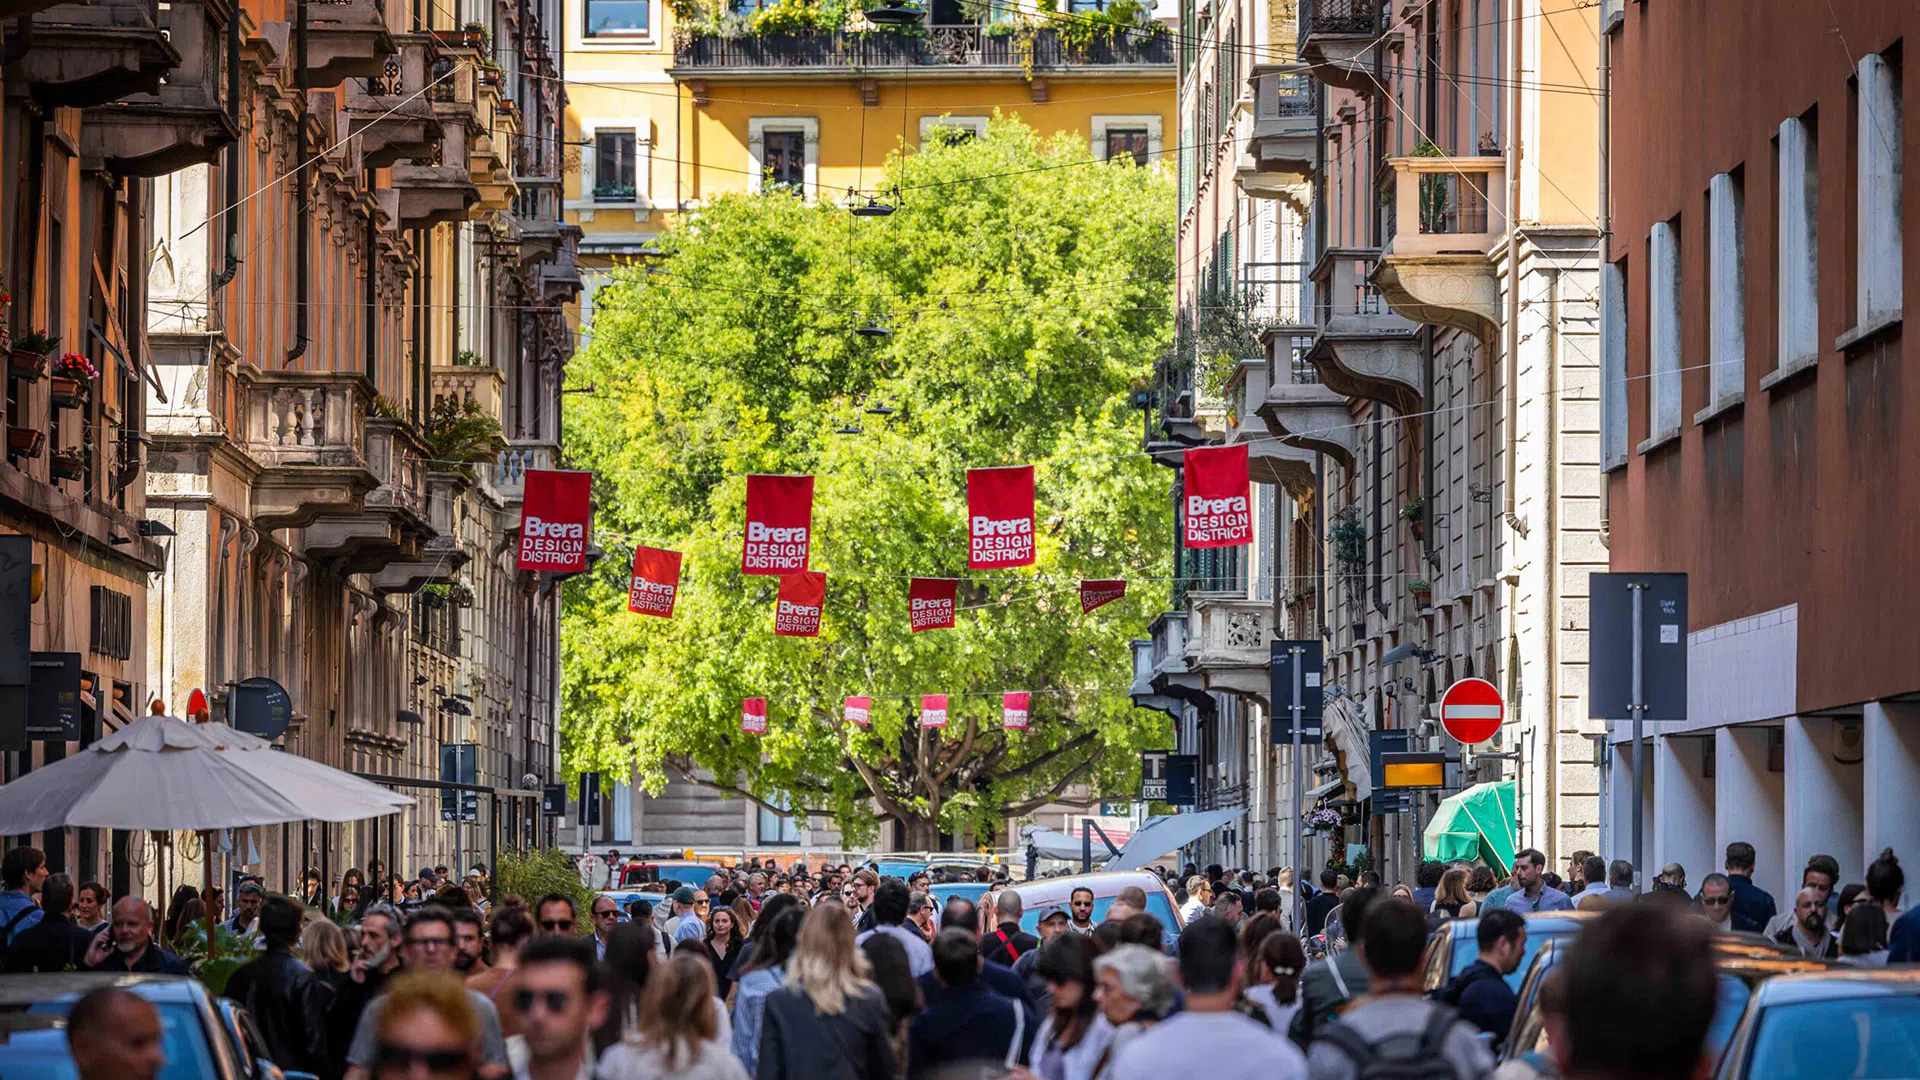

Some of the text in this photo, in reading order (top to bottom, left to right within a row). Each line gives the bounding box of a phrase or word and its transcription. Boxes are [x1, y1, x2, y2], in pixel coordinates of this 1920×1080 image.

[1188, 495, 1247, 515] Brera
[524, 516, 584, 539] Brera
[972, 516, 1031, 536] Brera
[1188, 512, 1248, 529] DESIGN
[748, 521, 807, 543] Brera
[1188, 525, 1248, 542] DISTRICT
[522, 538, 584, 552] DESIGN
[972, 533, 1032, 550] DESIGN
[521, 550, 582, 565] DISTRICT
[746, 543, 807, 557] DESIGN
[972, 546, 1032, 562] DISTRICT
[745, 556, 806, 569] DISTRICT
[633, 576, 675, 596] Brera
[631, 590, 673, 605] DESIGN
[911, 598, 952, 610] Brera
[630, 598, 671, 613] DISTRICT
[779, 600, 820, 616] Brera
[777, 614, 819, 625] DESIGN
[911, 608, 952, 619] DESIGN
[776, 622, 817, 633] DISTRICT
[912, 615, 952, 628] DISTRICT
[1144, 786, 1167, 798] BAR
